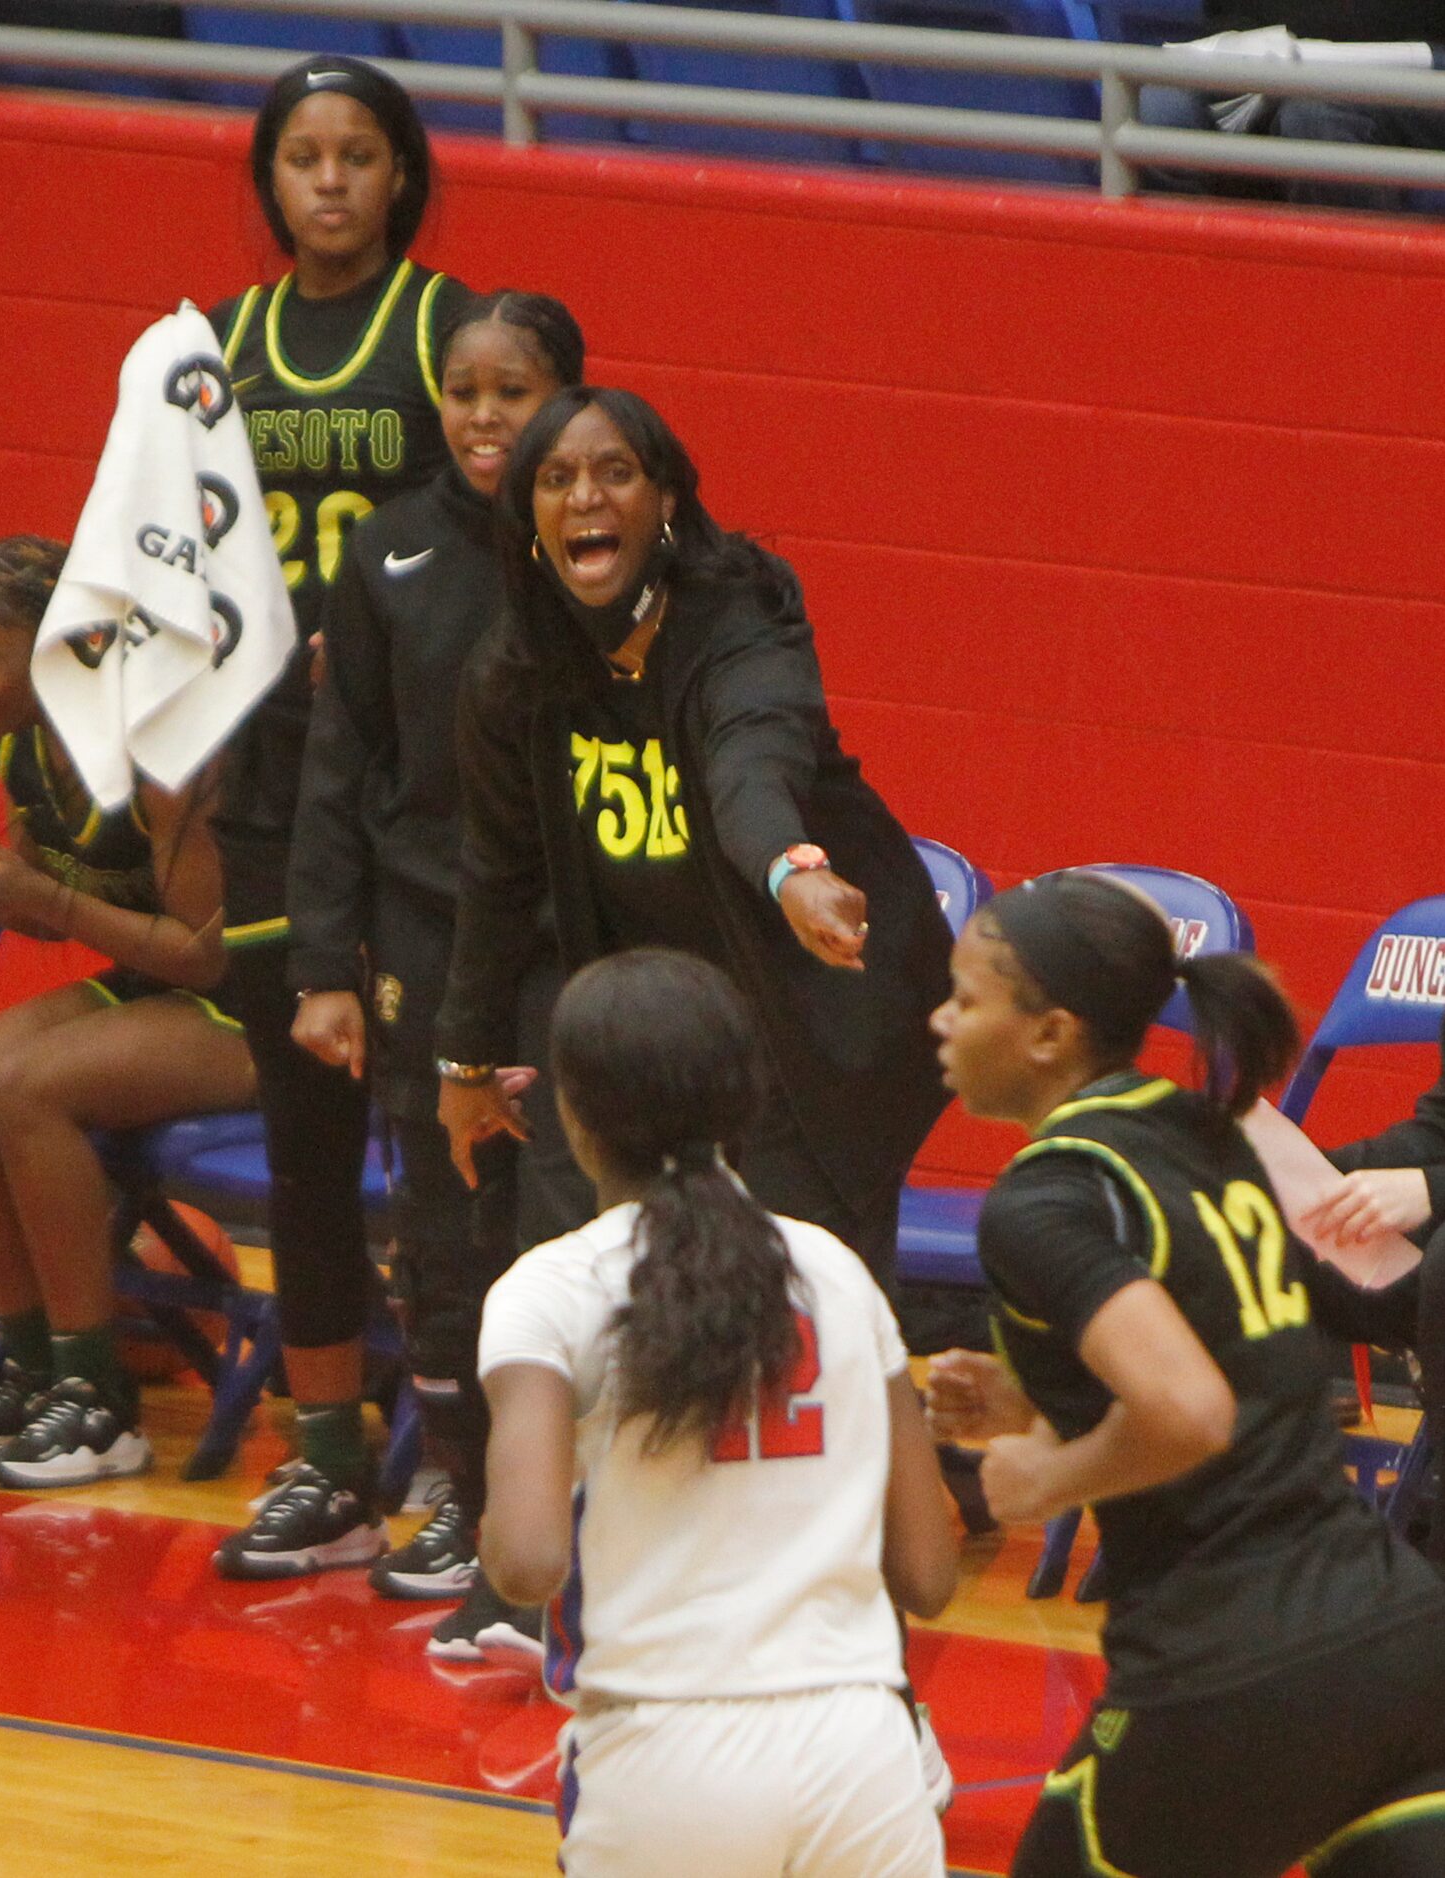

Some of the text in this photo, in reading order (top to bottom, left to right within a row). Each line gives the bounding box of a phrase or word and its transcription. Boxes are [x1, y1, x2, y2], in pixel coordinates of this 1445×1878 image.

[244, 408, 404, 471] ESOTO
[136, 522, 207, 583] GA
[1365, 934, 1445, 1003] DUNC
[1190, 1180, 1311, 1339] 12
